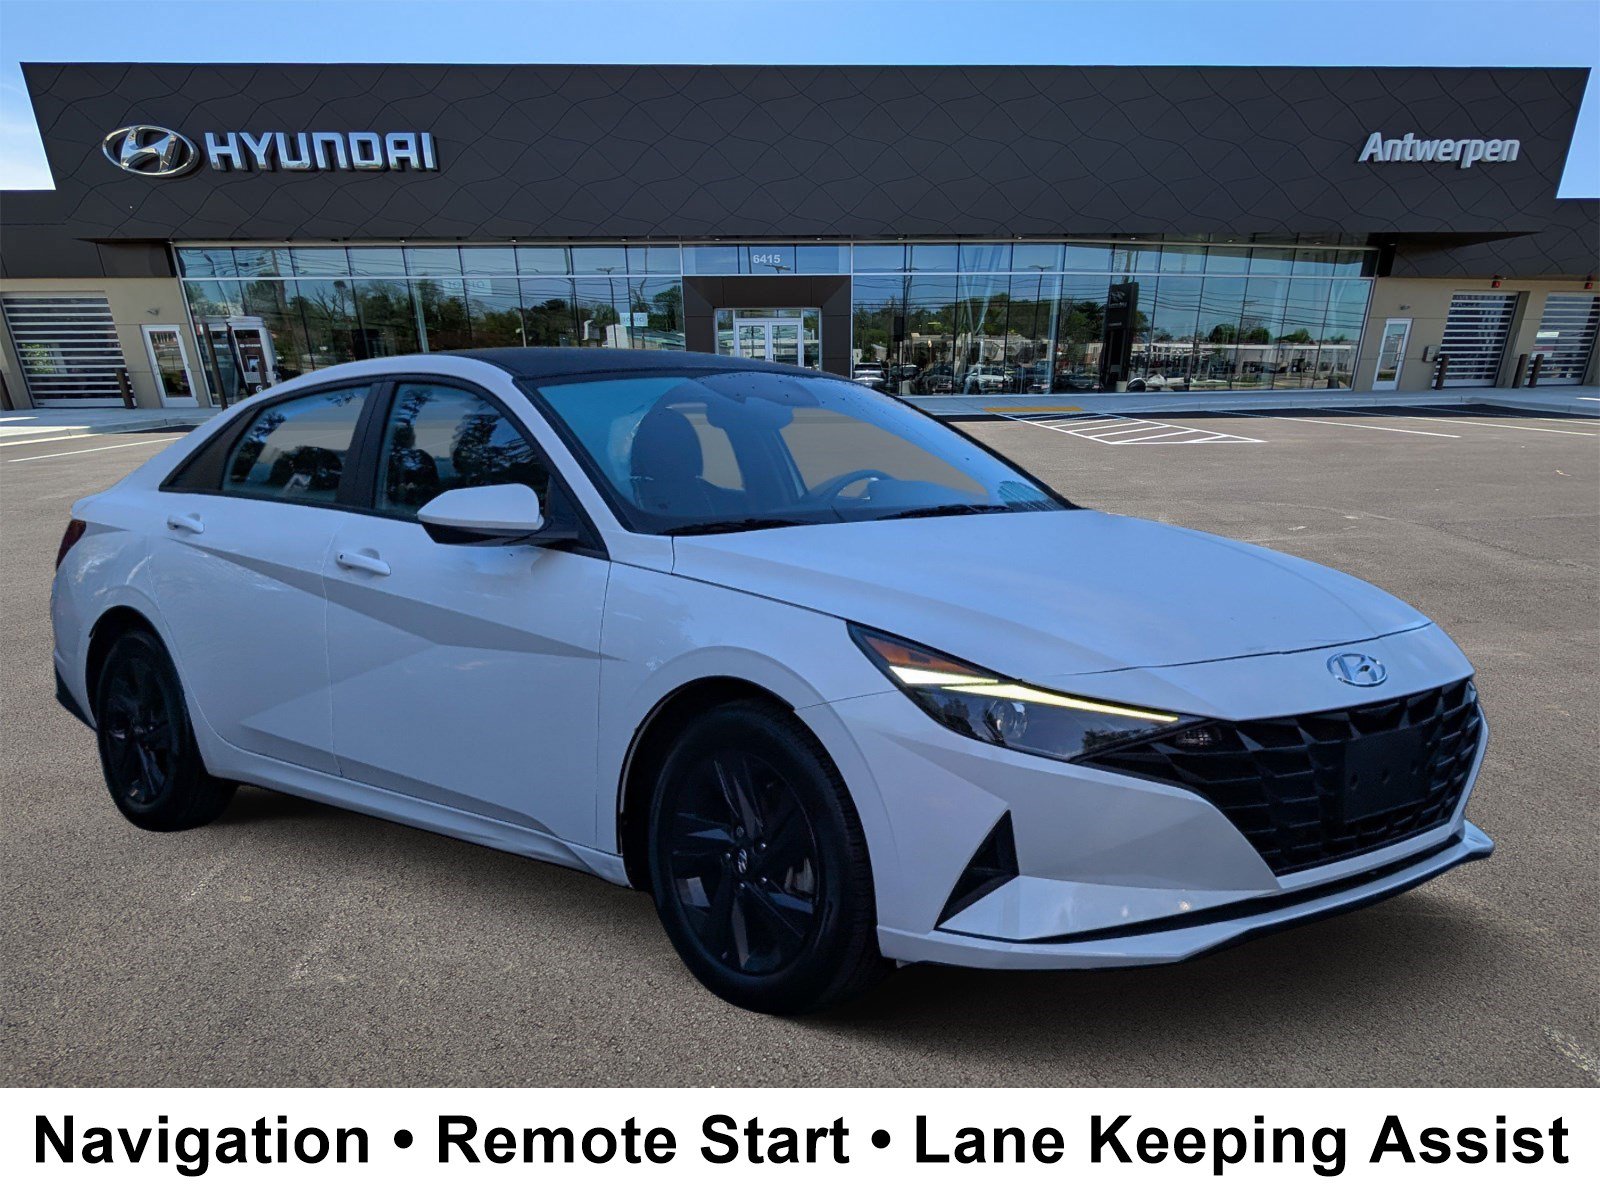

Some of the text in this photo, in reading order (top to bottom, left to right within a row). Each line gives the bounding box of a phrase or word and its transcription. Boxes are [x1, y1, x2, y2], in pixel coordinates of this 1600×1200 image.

[205, 132, 436, 170] HYUNDAI
[1357, 131, 1521, 169] Antwerpen
[753, 254, 781, 264] 6415
